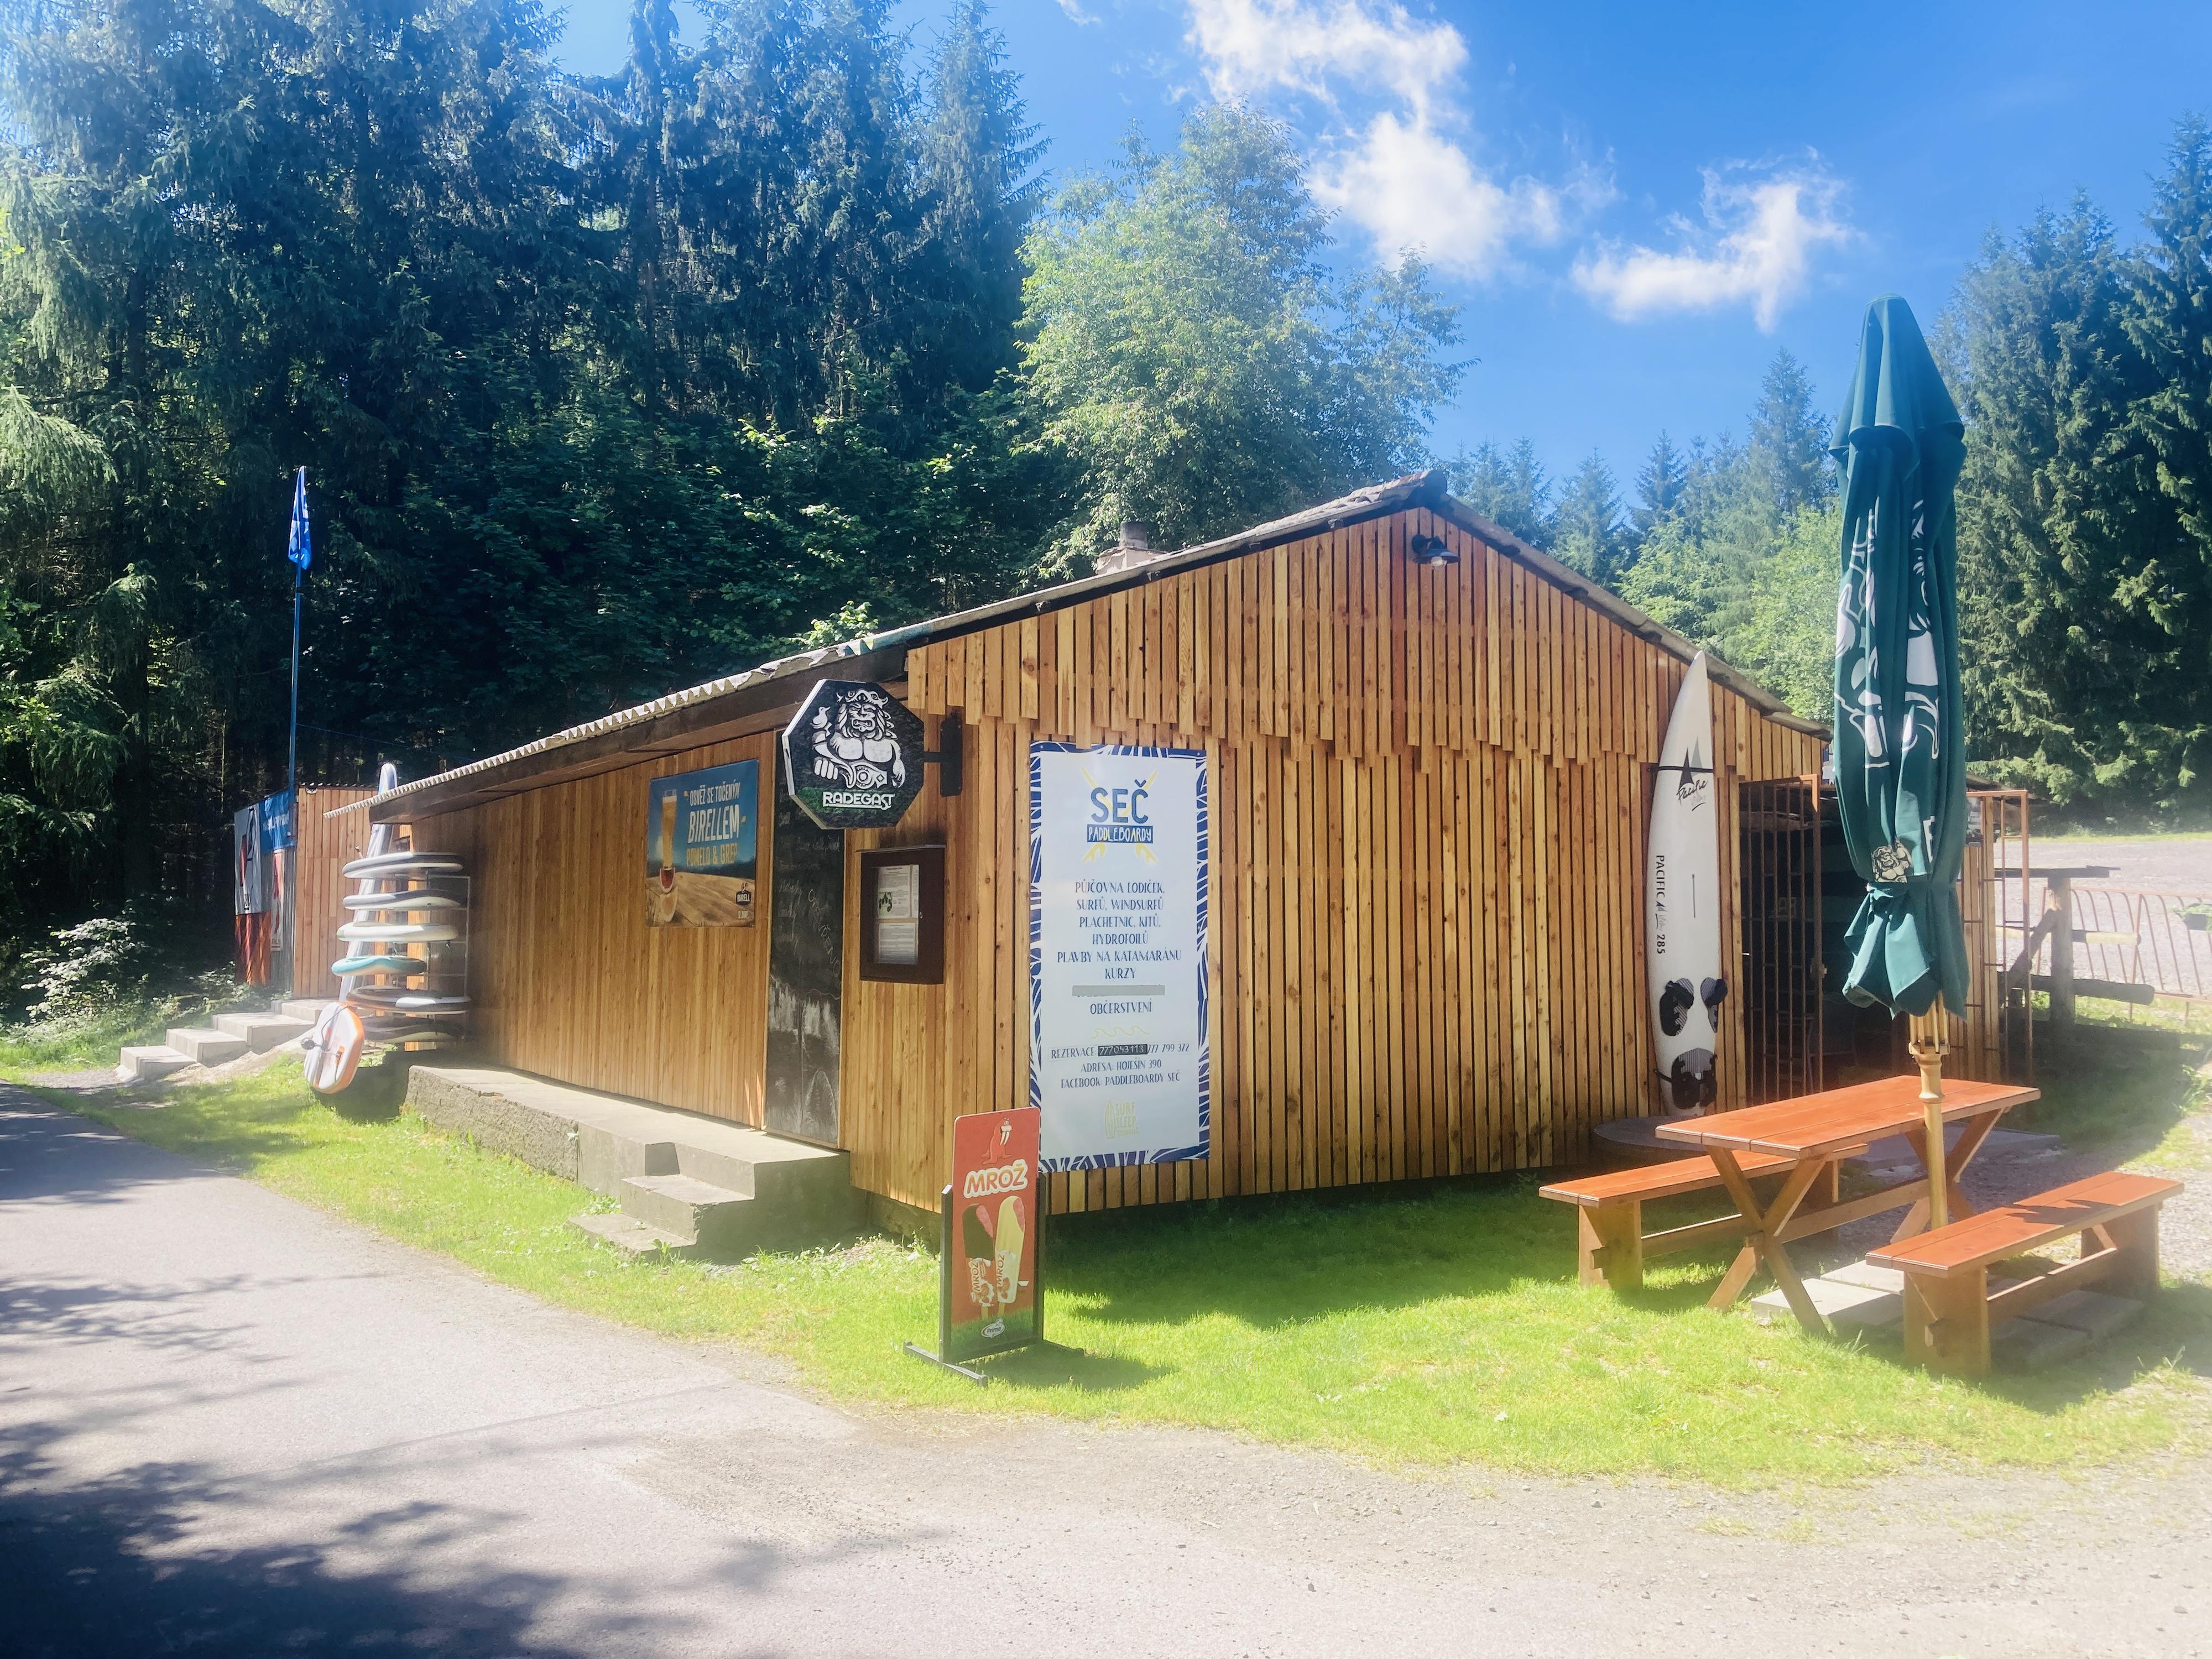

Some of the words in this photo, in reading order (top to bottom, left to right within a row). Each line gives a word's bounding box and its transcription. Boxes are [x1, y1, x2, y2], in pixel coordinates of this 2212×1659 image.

[690, 784, 706, 806] OSVĚŽ
[707, 786, 714, 804] SE
[716, 779, 741, 802] TOČENÝM
[823, 791, 895, 810] RADEGAST
[1091, 779, 1149, 824] SEČ
[687, 804, 740, 844] BIRELLEM
[1088, 826, 1151, 842] PADDLEBOARDY
[686, 847, 710, 867] POMELO
[712, 845, 718, 865] &
[1656, 855, 1666, 898] PACIFIC
[1075, 878, 1124, 894] PŮJČOVNA
[1110, 896, 1164, 910] WINDSURFŮ
[1092, 930, 1149, 945] HYDROFOILŮ
[1656, 933, 1666, 954] 285
[1057, 951, 1093, 963] PLAVBY
[1097, 951, 1111, 962] NA
[1114, 947, 1182, 962] KATAMARÁNU
[1105, 968, 1136, 979] KURZY
[1090, 998, 1152, 1014] OBČERSTVENÍ
[1161, 1044, 1175, 1053] 799
[1178, 1043, 1190, 1053] 372
[1117, 1057, 1146, 1071] HOJEŠÍN
[1149, 1059, 1162, 1069] 390
[1105, 1073, 1164, 1086] PADDLEBOARDY
[1167, 1069, 1181, 1082] SEČ
[1115, 1102, 1135, 1115] SURF
[1115, 1116, 1136, 1128] SLEEP
[967, 1164, 1025, 1194] MROŽ
